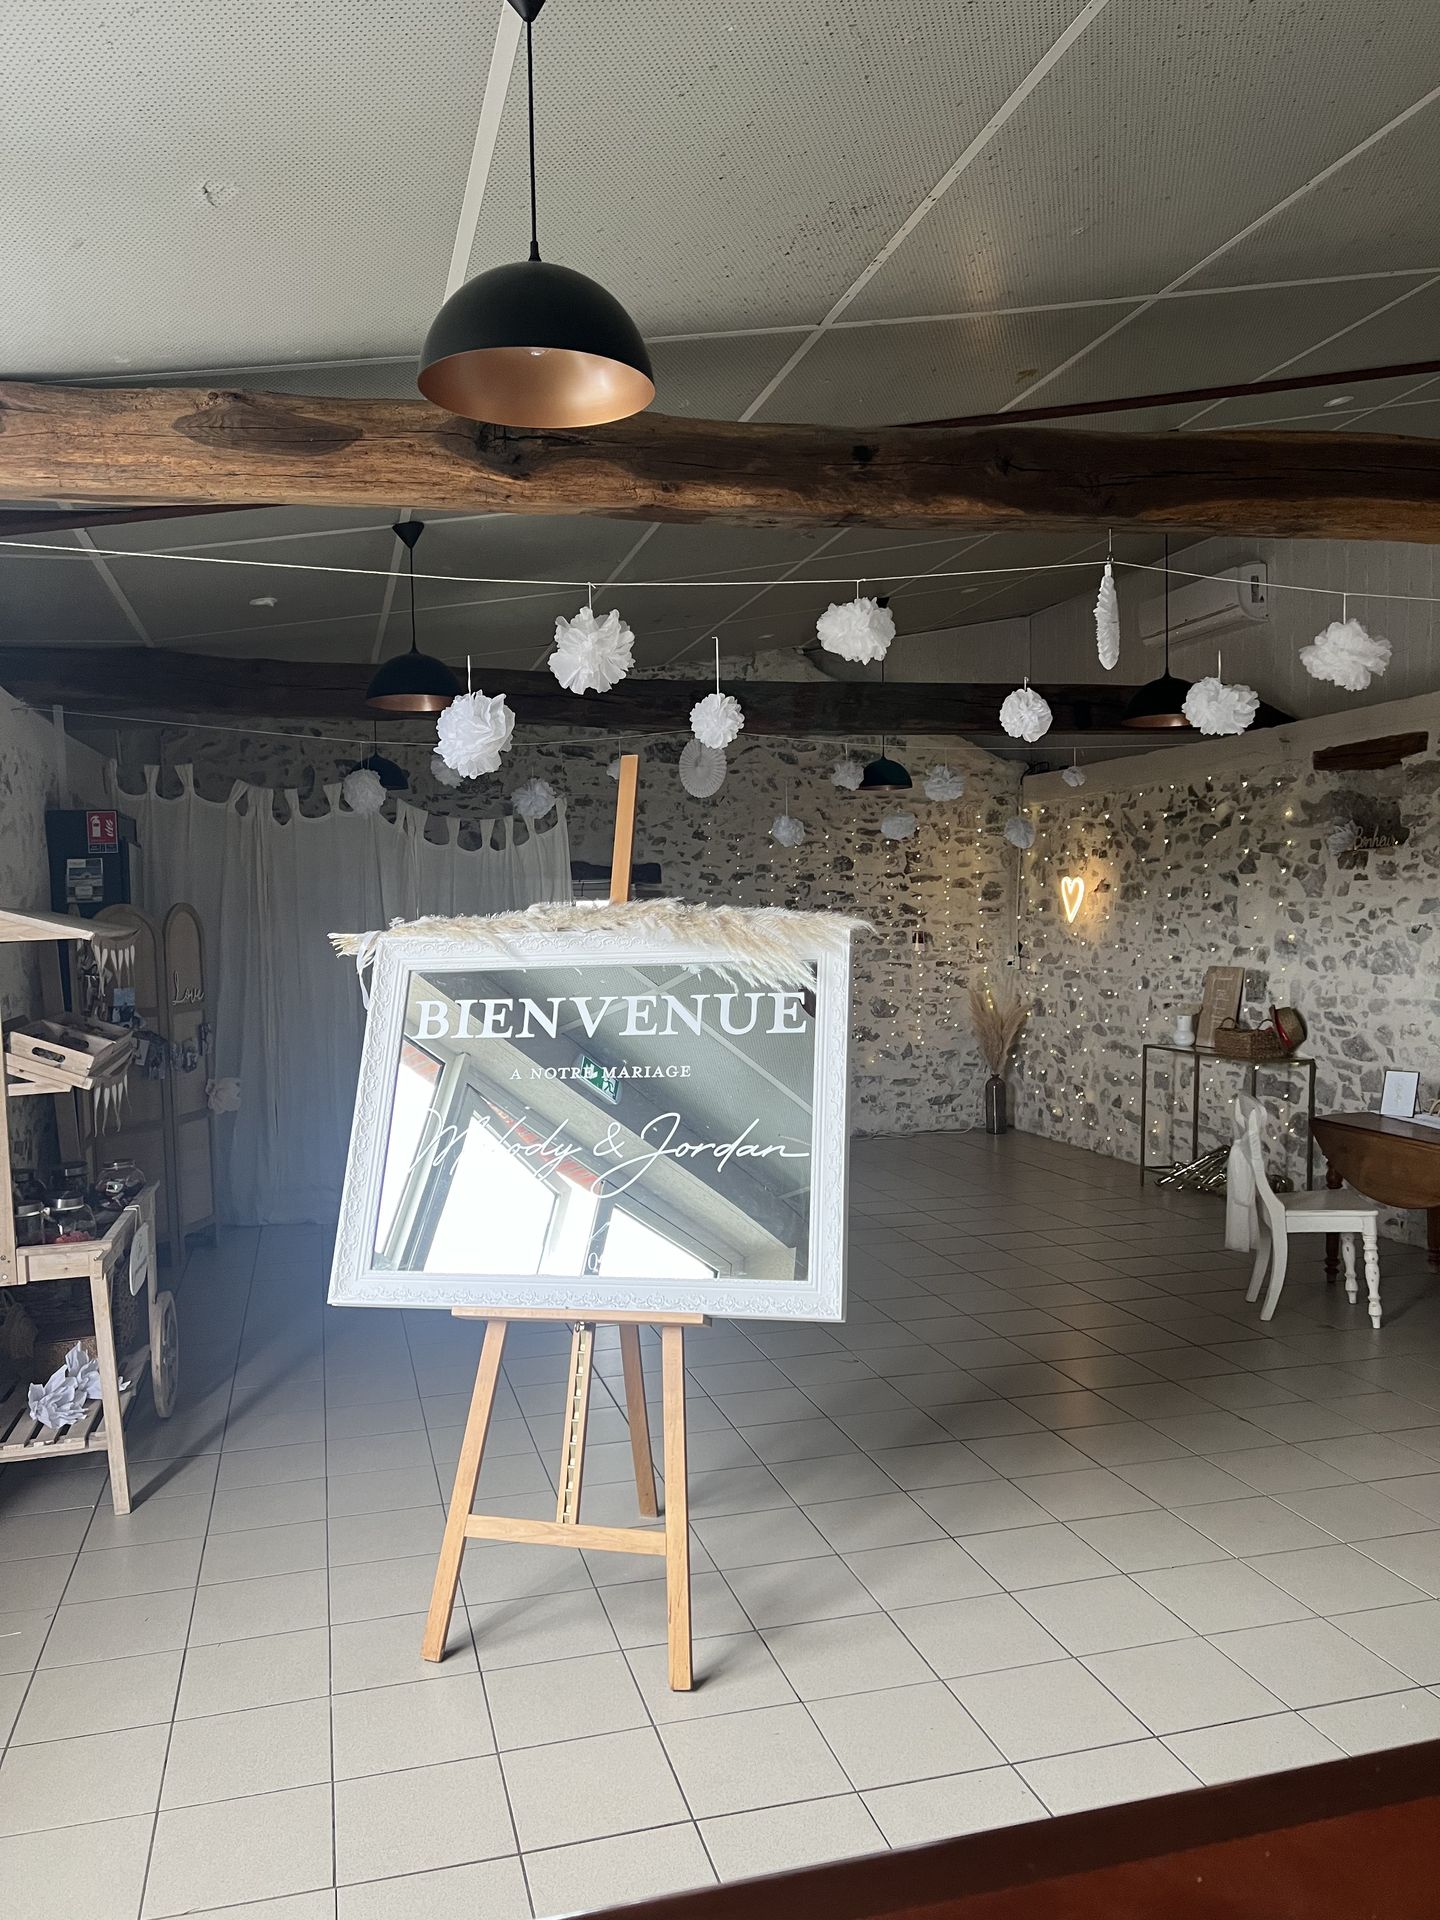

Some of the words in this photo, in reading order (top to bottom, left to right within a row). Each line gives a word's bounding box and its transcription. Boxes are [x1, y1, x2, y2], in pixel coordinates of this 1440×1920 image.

[172, 970, 205, 1006] Love
[414, 991, 807, 1040] BIENVENUE
[509, 1068, 522, 1080] A
[530, 1066, 594, 1080] NOTRE
[602, 1064, 692, 1080] MARIAGE
[407, 1107, 582, 1181] Mlody
[591, 1112, 810, 1198] Jordan
[592, 1121, 626, 1158] &
